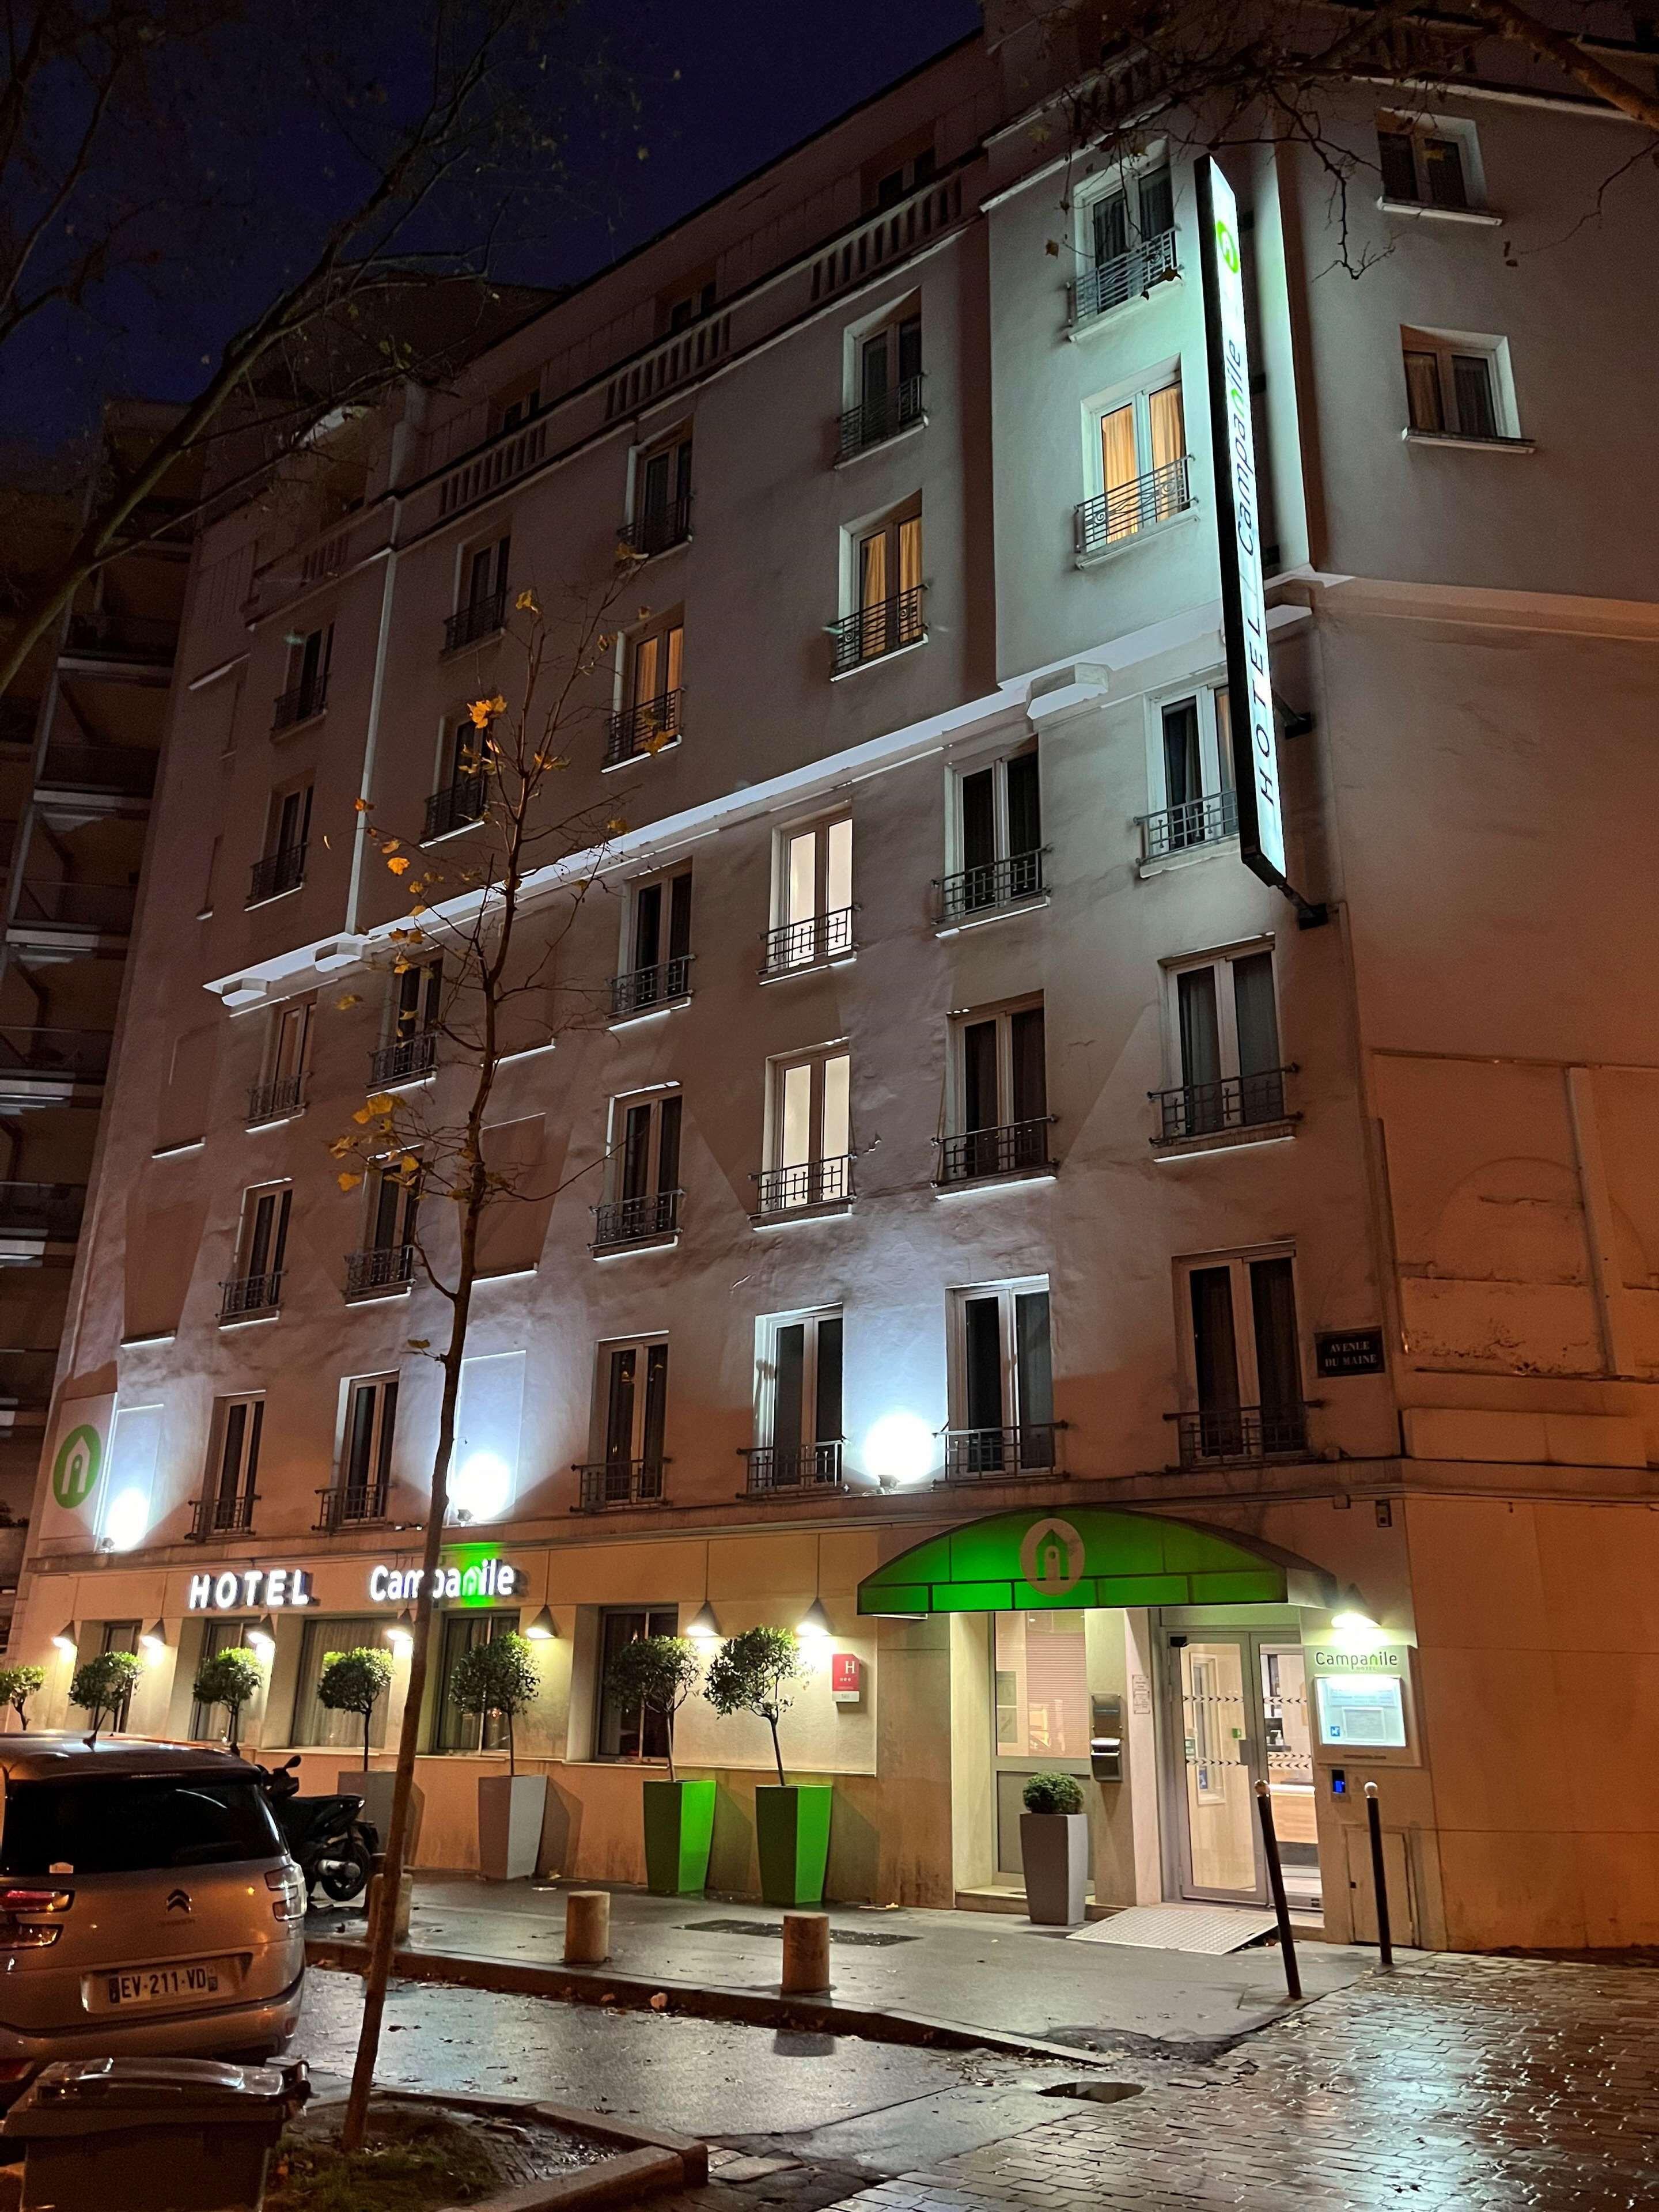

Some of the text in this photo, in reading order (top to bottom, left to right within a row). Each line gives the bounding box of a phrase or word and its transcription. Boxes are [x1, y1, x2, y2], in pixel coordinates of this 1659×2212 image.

[1226, 339, 1274, 806] HOTEL Campanile
[1331, 1341, 1370, 1353] AVENUE
[1325, 1354, 1377, 1367] DU MAINE
[189, 1569, 309, 1608] HOTEL
[845, 1661, 855, 1673] H
[1316, 1652, 1397, 1669] Campanile
